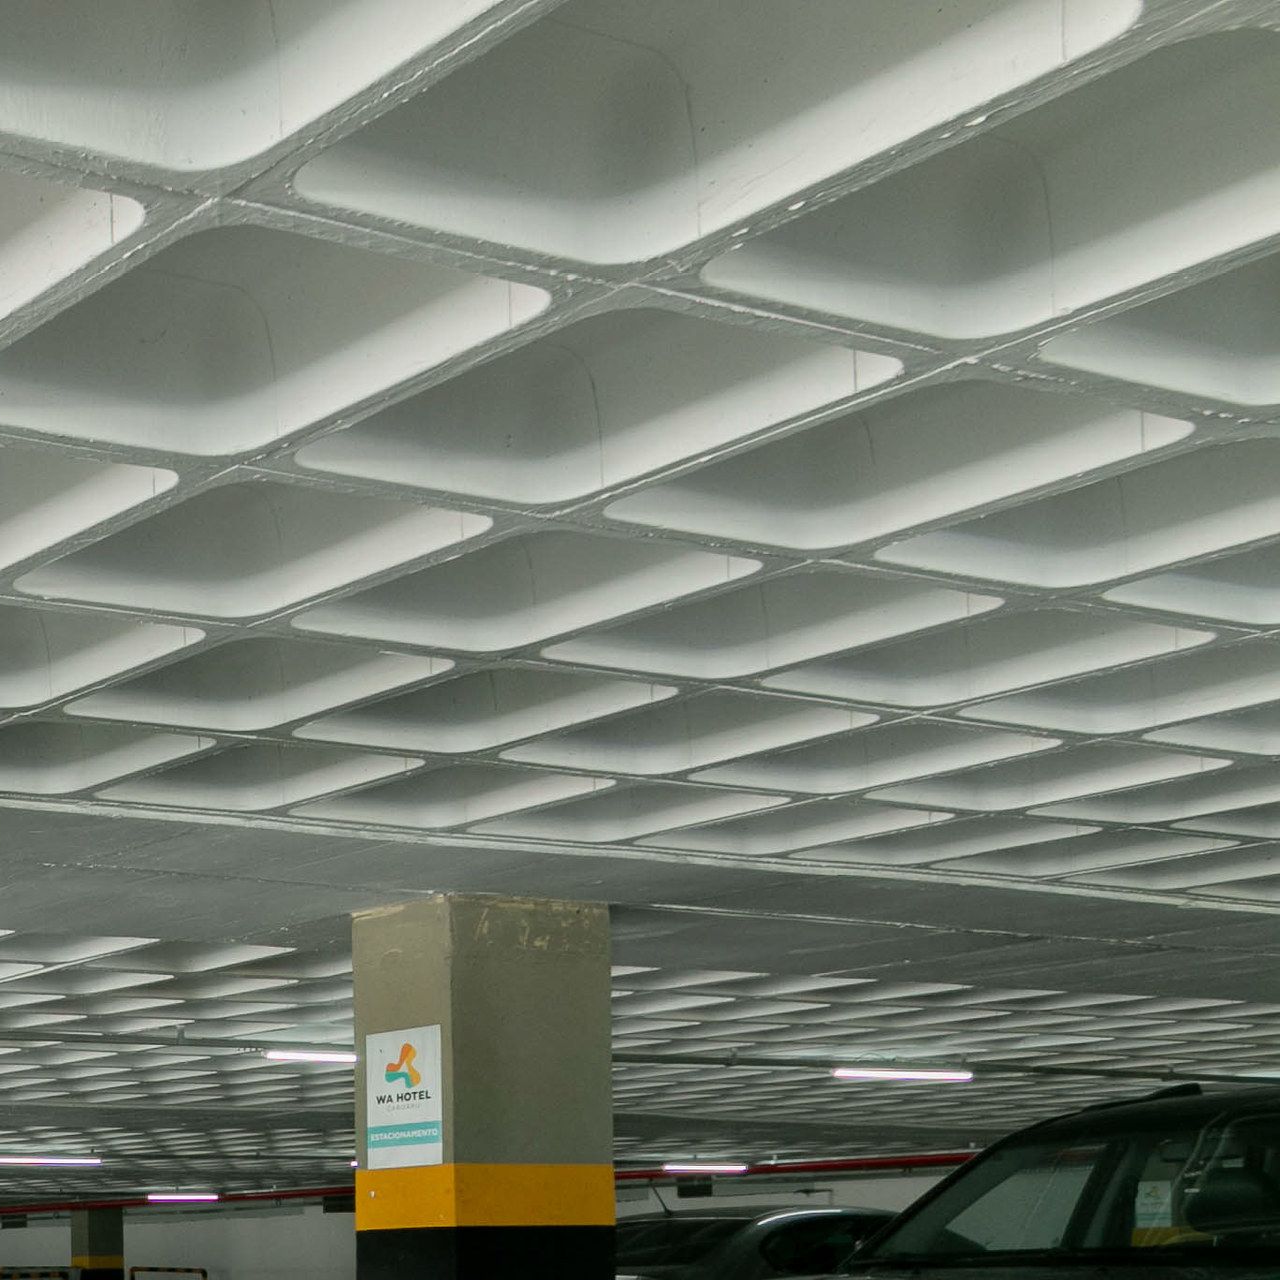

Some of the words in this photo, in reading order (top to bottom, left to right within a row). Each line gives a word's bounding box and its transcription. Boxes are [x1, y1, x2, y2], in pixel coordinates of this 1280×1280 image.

[376, 1094, 393, 1105] WA
[396, 1090, 432, 1103] HOTEL
[371, 1128, 438, 1140] ESTACIONAMENTO
